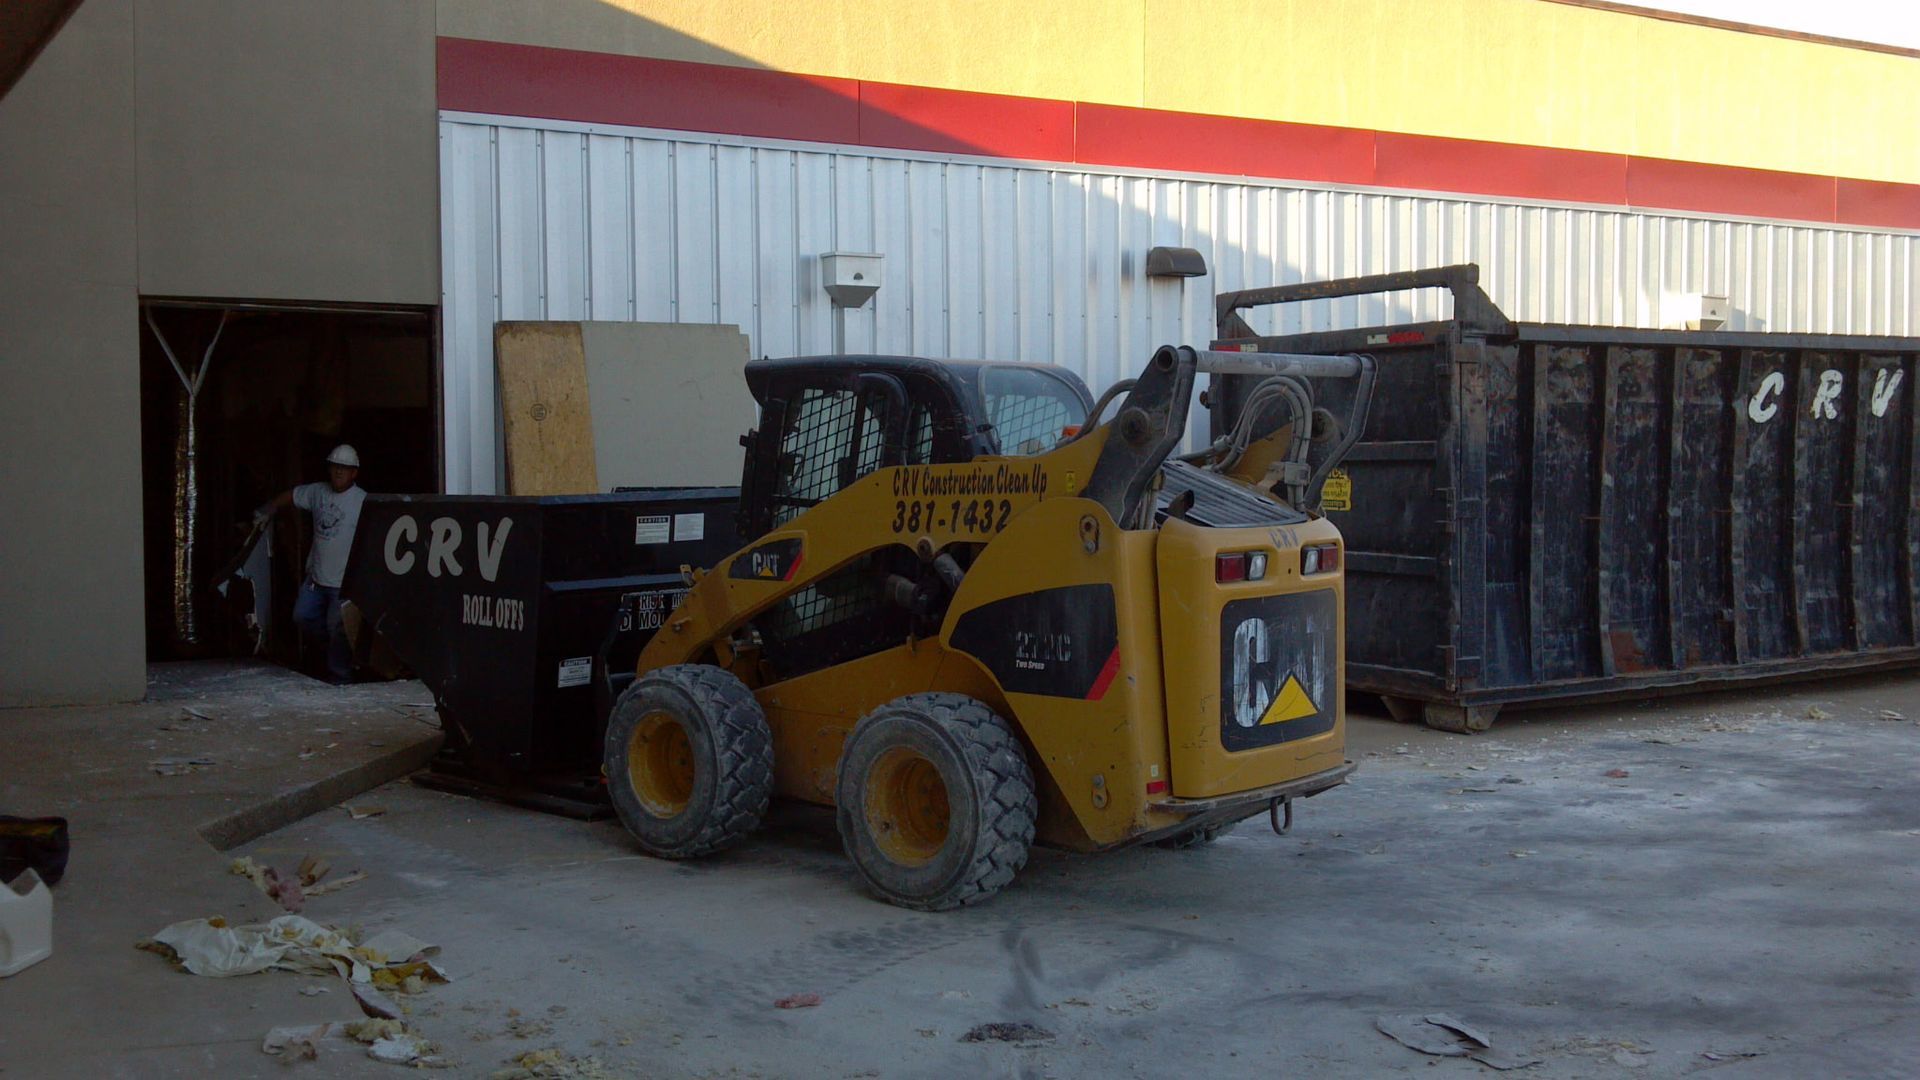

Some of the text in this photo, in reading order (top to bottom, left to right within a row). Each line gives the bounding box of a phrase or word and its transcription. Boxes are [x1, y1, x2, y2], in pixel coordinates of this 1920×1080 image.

[922, 466, 994, 496] Construction
[996, 464, 1029, 495] Clean
[1032, 463, 1048, 502] Up
[892, 499, 1012, 533] 381-1432
[383, 514, 514, 583] CRV
[1269, 528, 1299, 549] CRV
[752, 551, 780, 577] CAT
[462, 593, 524, 632] ROLL OFFS
